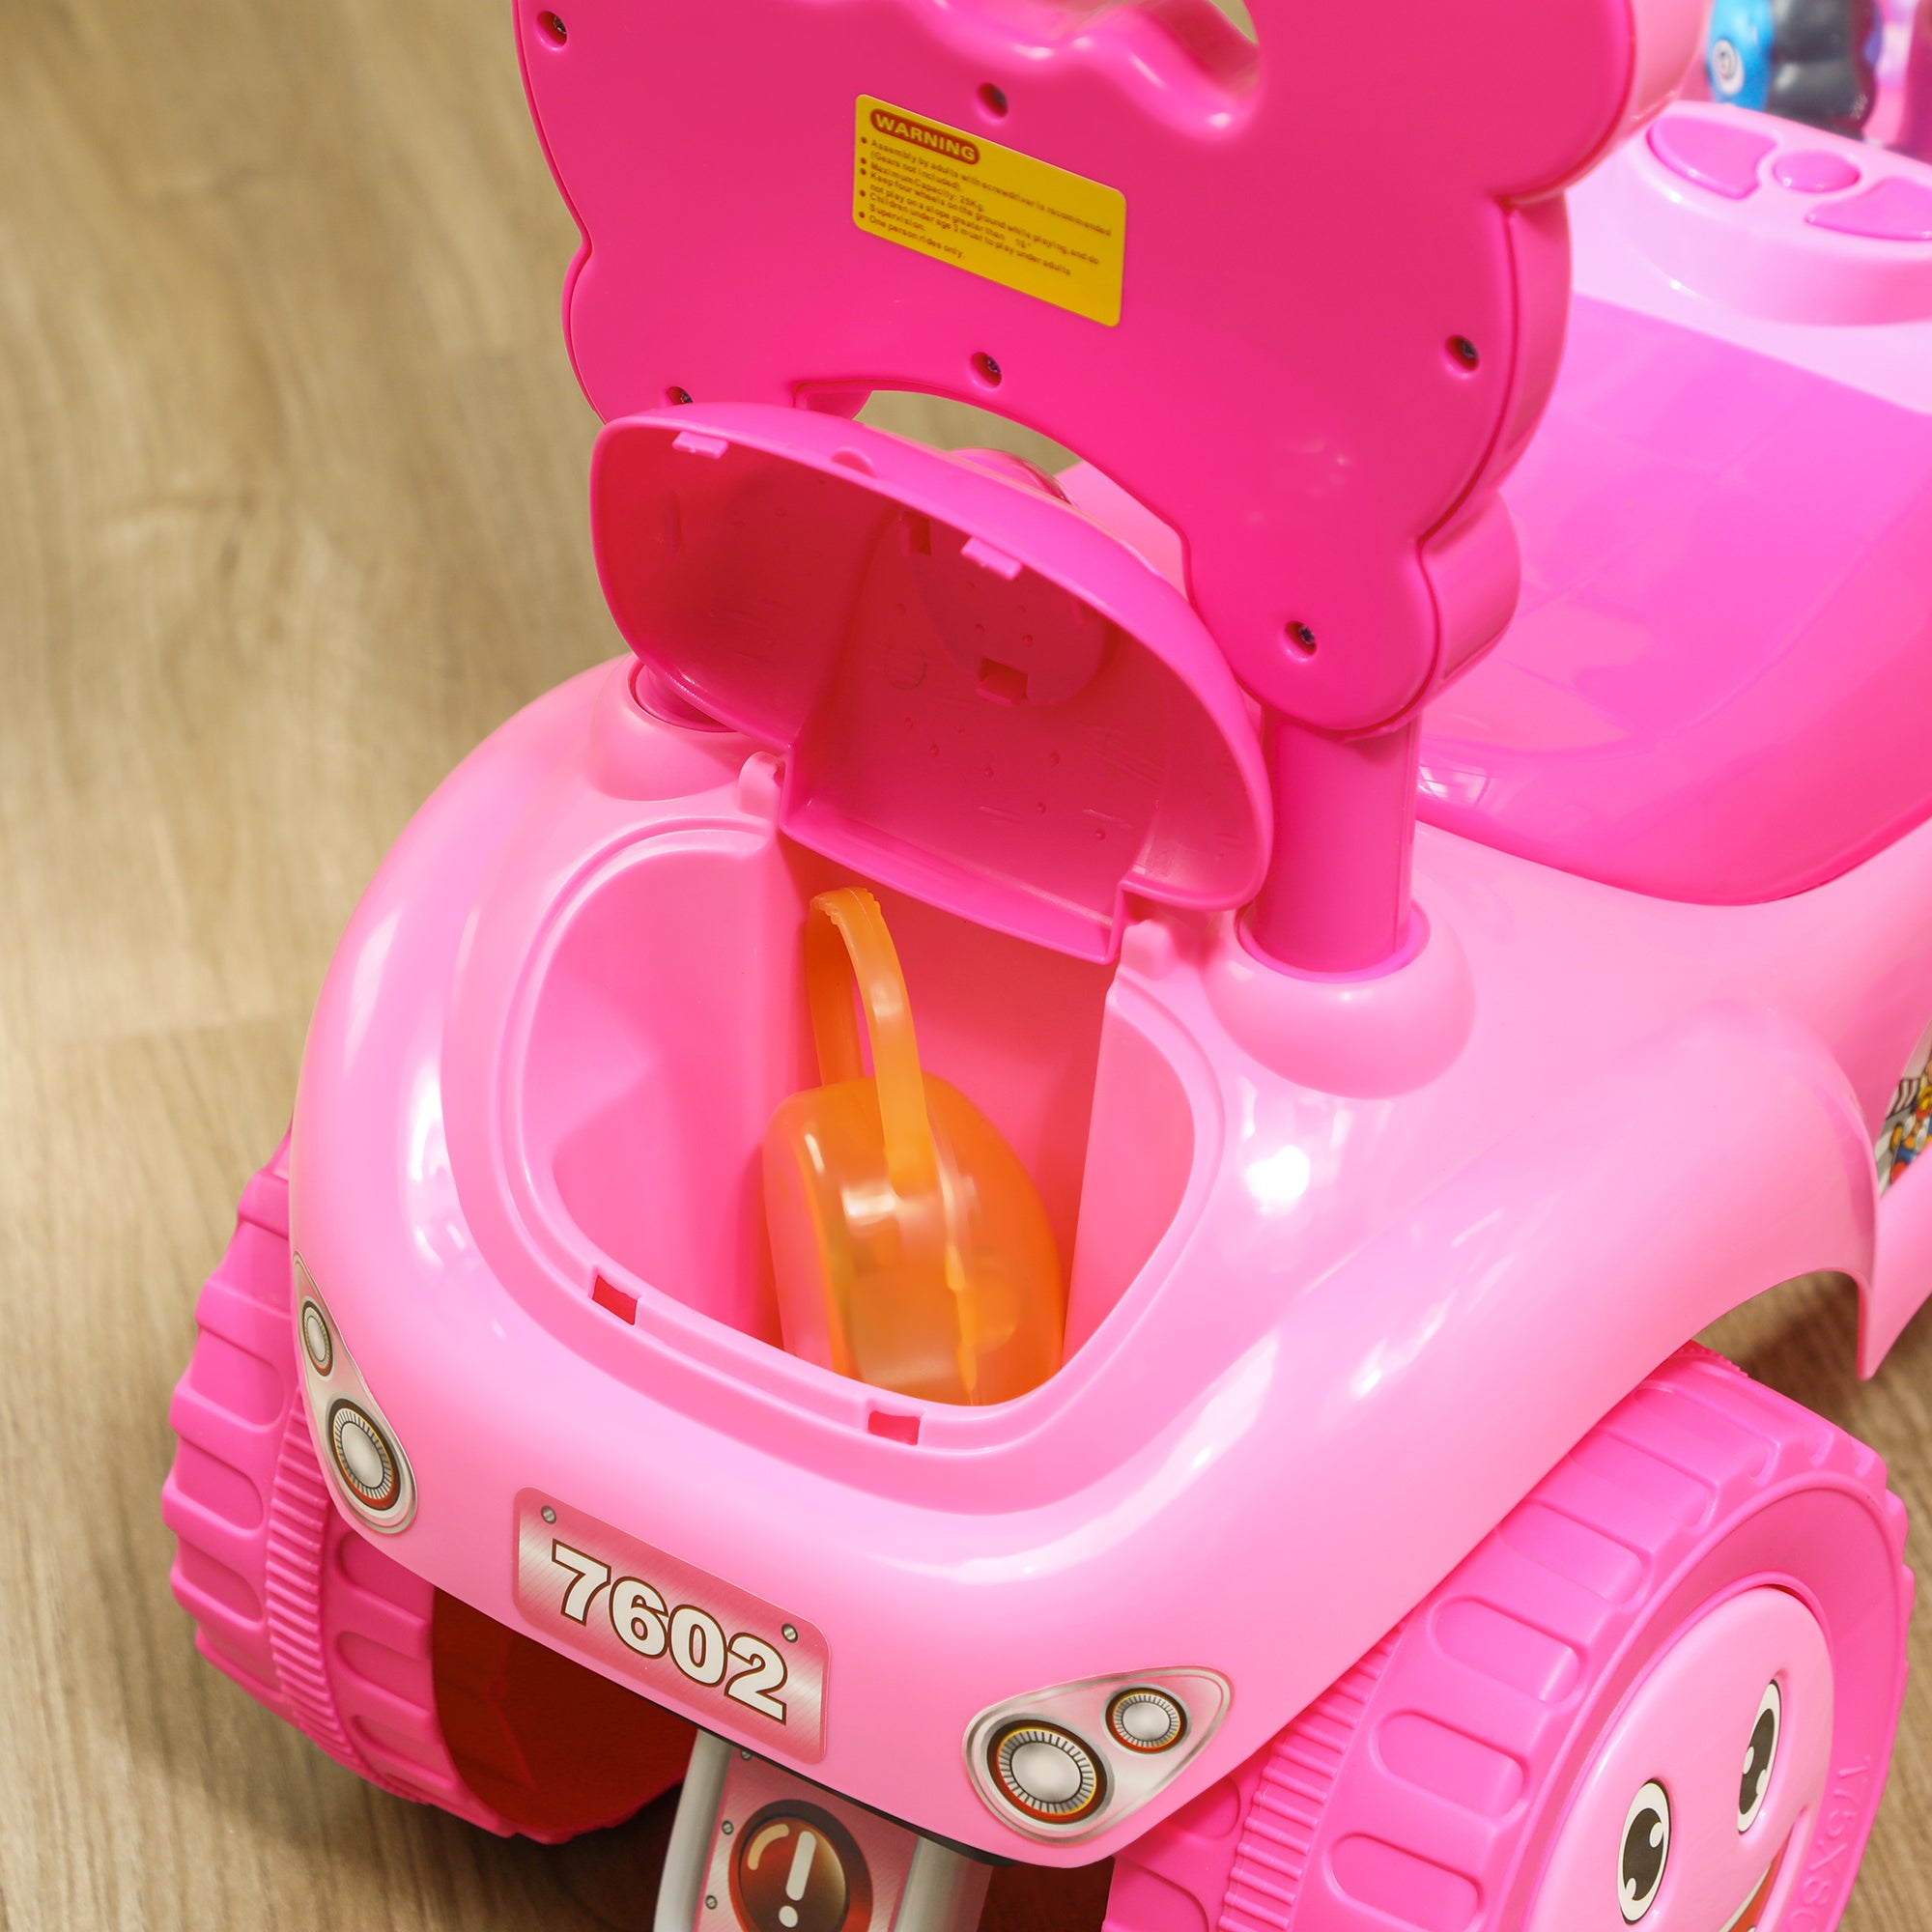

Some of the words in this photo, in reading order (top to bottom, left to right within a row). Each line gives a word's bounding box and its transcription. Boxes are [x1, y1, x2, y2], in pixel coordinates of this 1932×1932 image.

[871, 139, 916, 163] Assembly
[931, 162, 957, 177] adults
[876, 114, 975, 160] WARNING
[902, 163, 915, 173] not
[870, 185, 883, 193] not
[886, 189, 904, 203] play
[926, 205, 949, 219] slope
[952, 215, 982, 233] greater
[985, 228, 1004, 240] than
[915, 189, 944, 206] wheels
[959, 207, 972, 215] the
[975, 213, 1005, 230] ground
[869, 215, 885, 227] One
[889, 224, 917, 240] person
[920, 235, 941, 248] rides
[869, 192, 907, 213] Children
[911, 210, 933, 222] under
[936, 219, 951, 231] age
[960, 229, 981, 241] must
[996, 242, 1012, 254] play
[1017, 250, 1040, 263] under
[1043, 260, 1070, 275] adults
[552, 1539, 788, 1725] 7602
